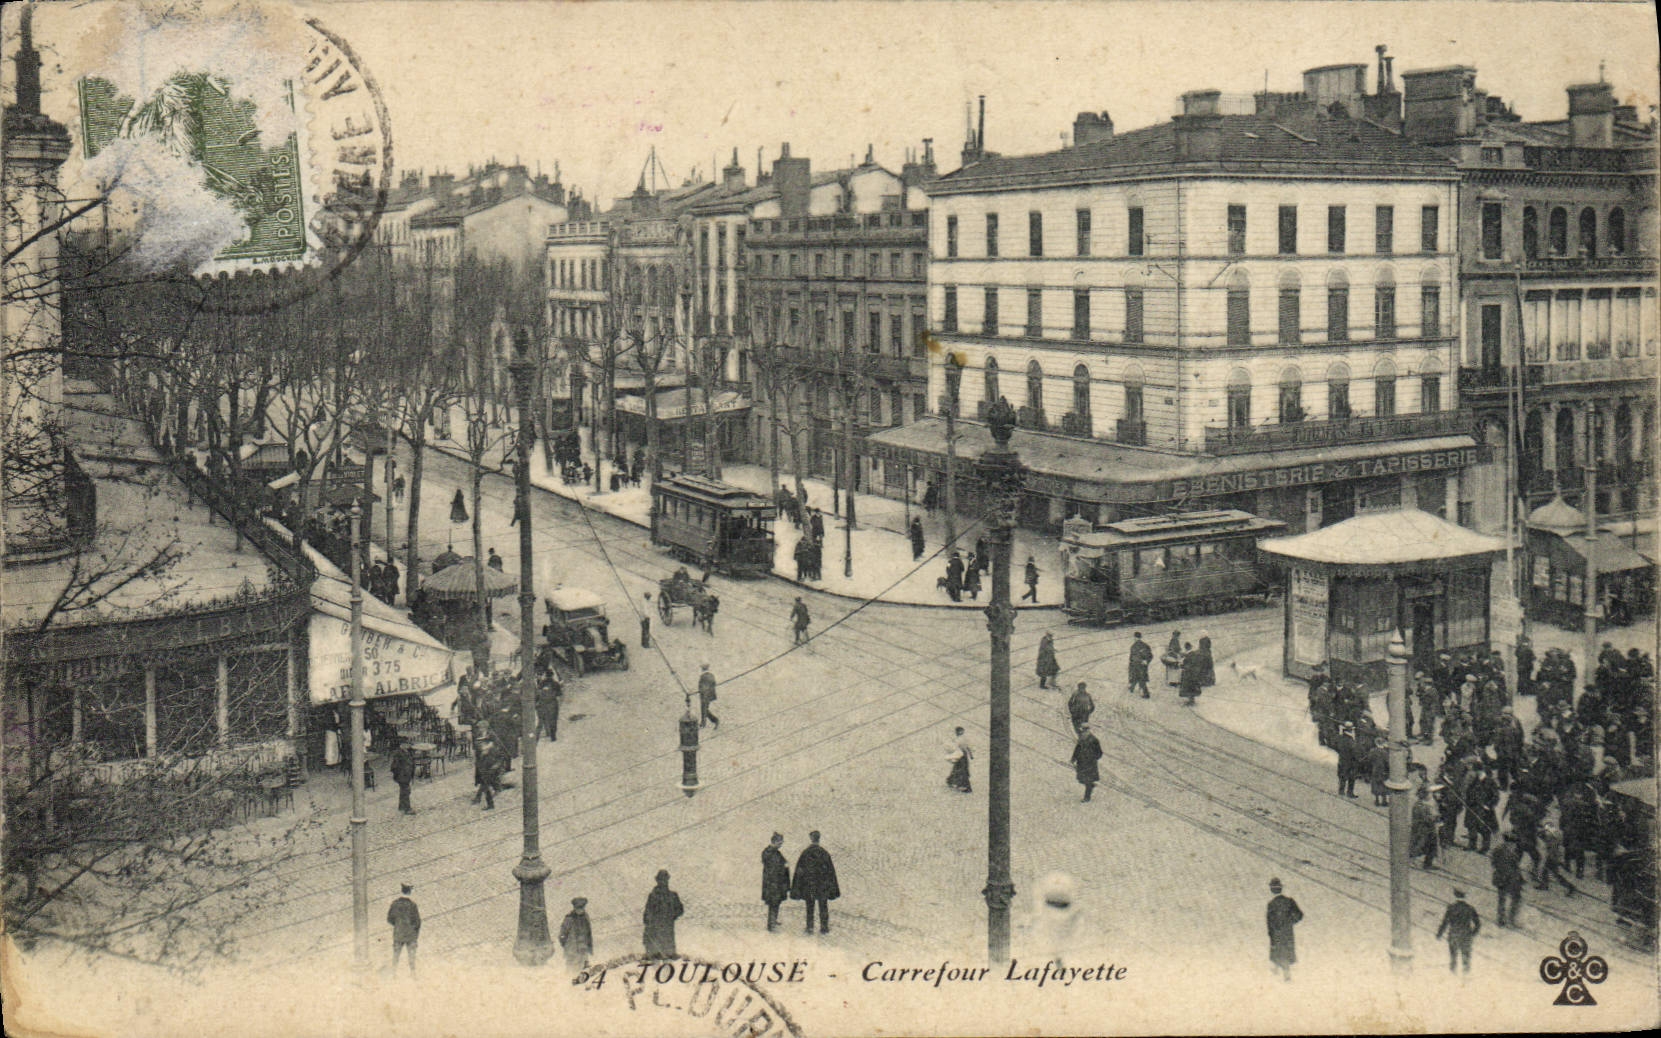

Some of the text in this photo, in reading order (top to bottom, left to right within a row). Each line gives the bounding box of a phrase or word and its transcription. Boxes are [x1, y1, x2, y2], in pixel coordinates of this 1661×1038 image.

[271, 154, 294, 239] POSTES
[1172, 448, 1479, 498] EBENISTERIE & TAPISSERIE
